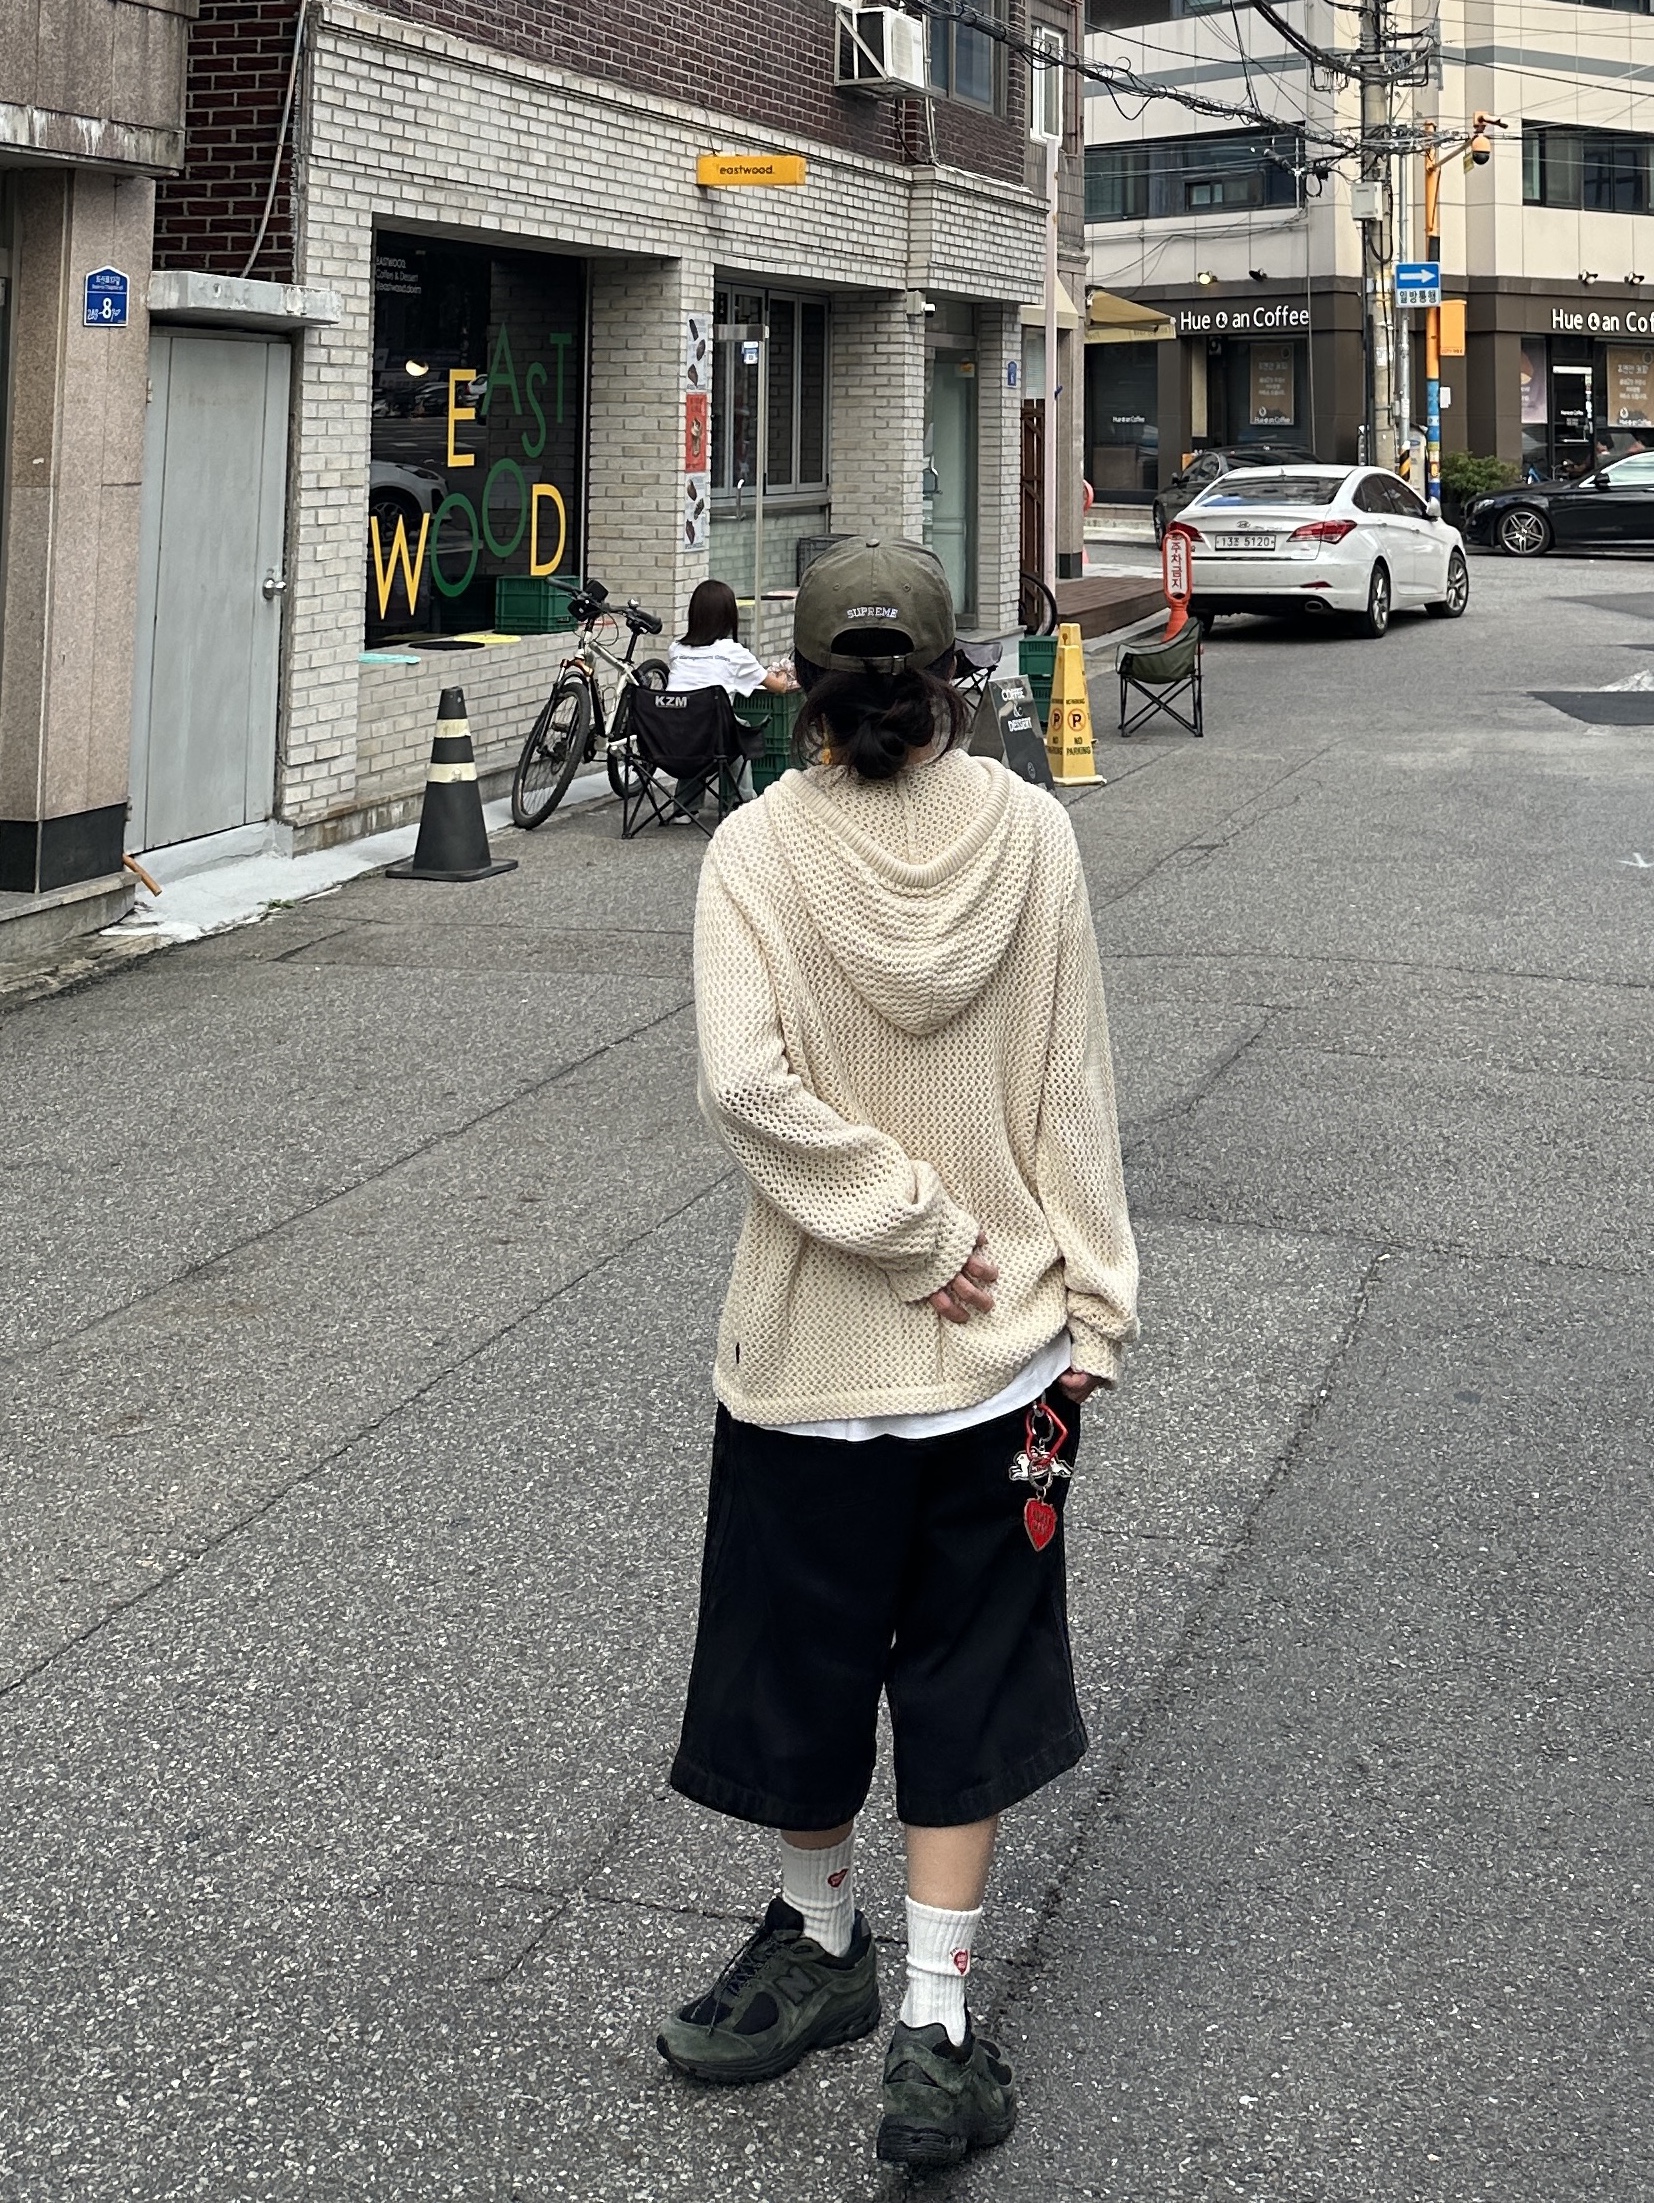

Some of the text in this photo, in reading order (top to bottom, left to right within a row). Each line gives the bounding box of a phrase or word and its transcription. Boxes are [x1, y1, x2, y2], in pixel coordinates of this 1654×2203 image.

[1399, 290, 1437, 304] 일방통행
[102, 297, 112, 319] 8
[1180, 311, 1211, 330] Hue
[1253, 305, 1309, 328] Coffee
[1552, 308, 1583, 330] Hue
[370, 458, 567, 620] WOOD
[1243, 536, 1270, 547] 5120
[1171, 541, 1182, 589] 주차금지
[846, 606, 899, 619] SUPREME
[655, 695, 688, 708] KZM
[1074, 736, 1083, 745] NO
[1066, 746, 1091, 756] PARKING
